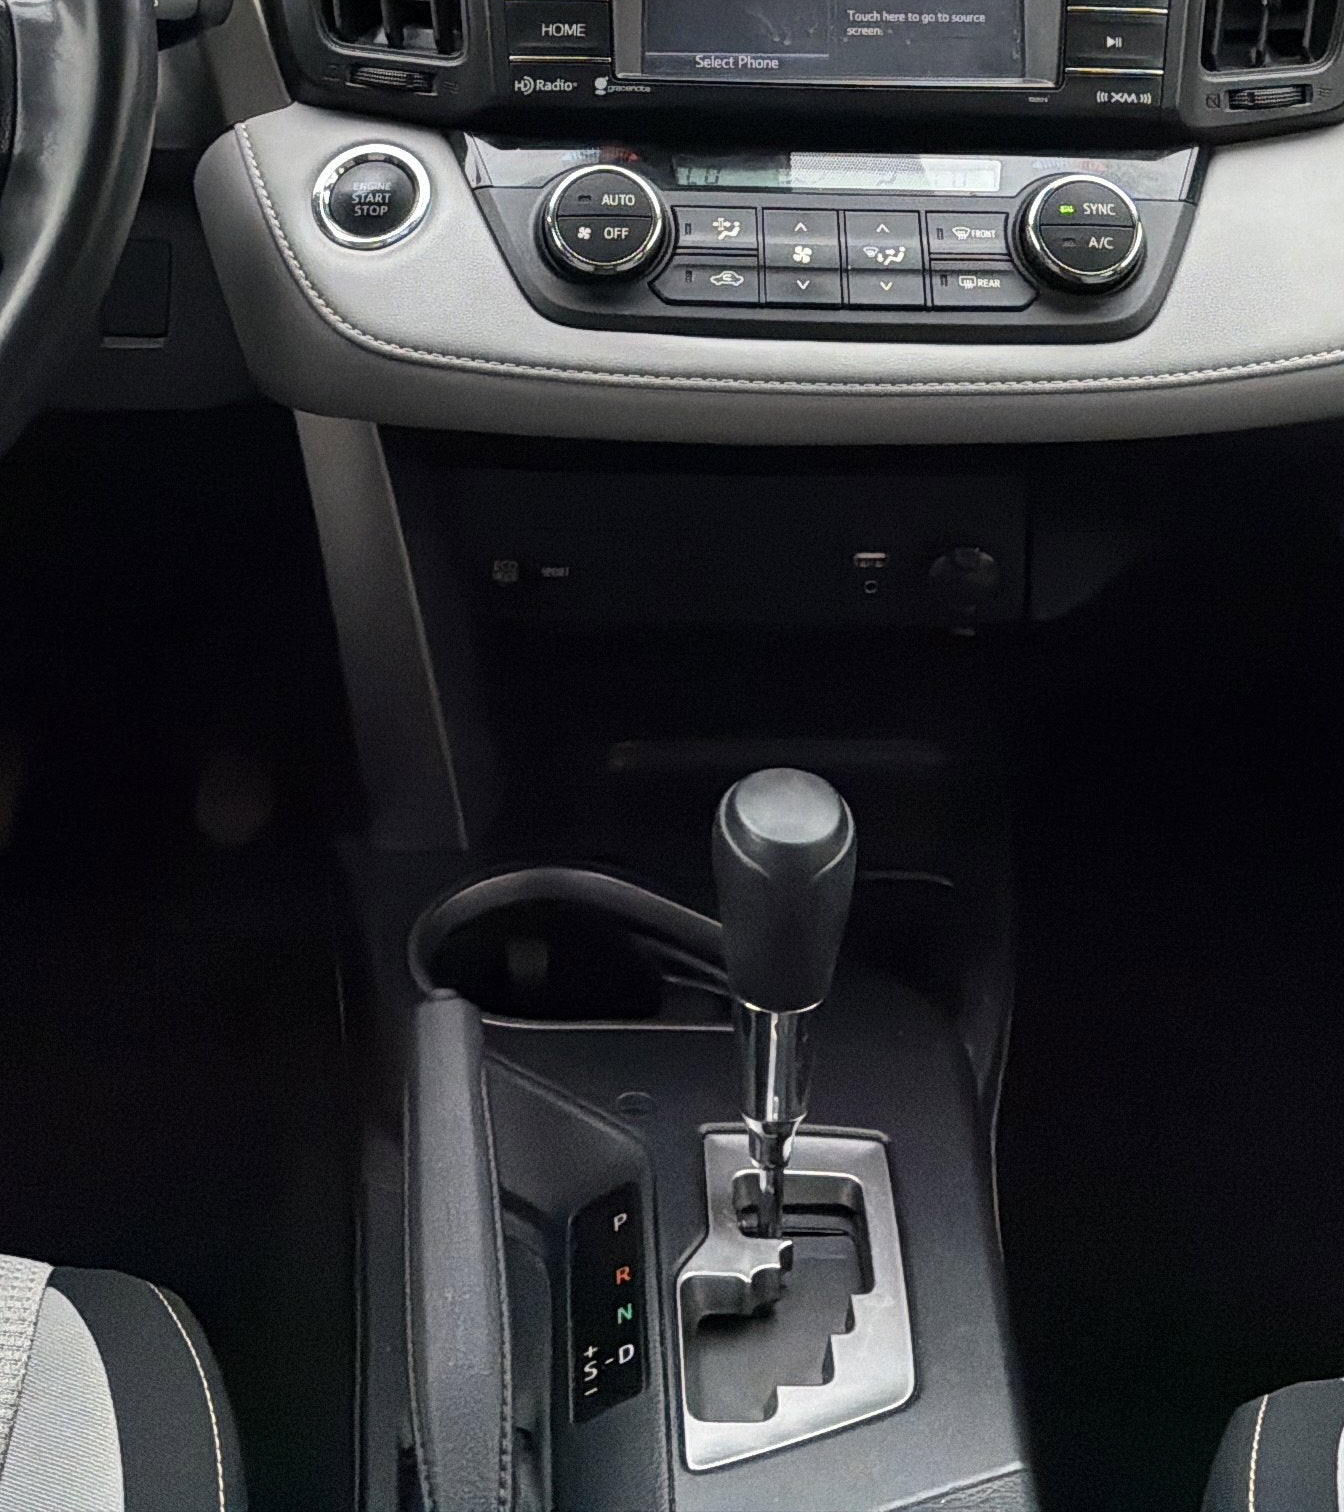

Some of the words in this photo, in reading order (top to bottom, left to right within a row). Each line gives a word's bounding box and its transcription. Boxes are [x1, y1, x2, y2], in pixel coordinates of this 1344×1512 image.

[847, 9, 880, 23] Touch
[882, 10, 906, 23] here
[908, 12, 919, 24] to
[921, 14, 937, 27] go
[937, 12, 949, 24] to
[951, 14, 986, 24] source
[541, 23, 587, 37] HOME
[695, 54, 735, 69] Select
[737, 55, 779, 70] Phone
[352, 181, 392, 191] ENGINE
[351, 192, 392, 205] START
[601, 194, 636, 207] AUTO
[353, 204, 389, 218] STOP
[1083, 202, 1117, 217] SYNC
[603, 226, 629, 240] OFF
[971, 229, 997, 239] FRONT
[1088, 236, 1115, 251] A/C
[977, 278, 1001, 289] REAR
[613, 1212, 628, 1232] P
[615, 1265, 632, 1285] R
[617, 1302, 633, 1325] N
